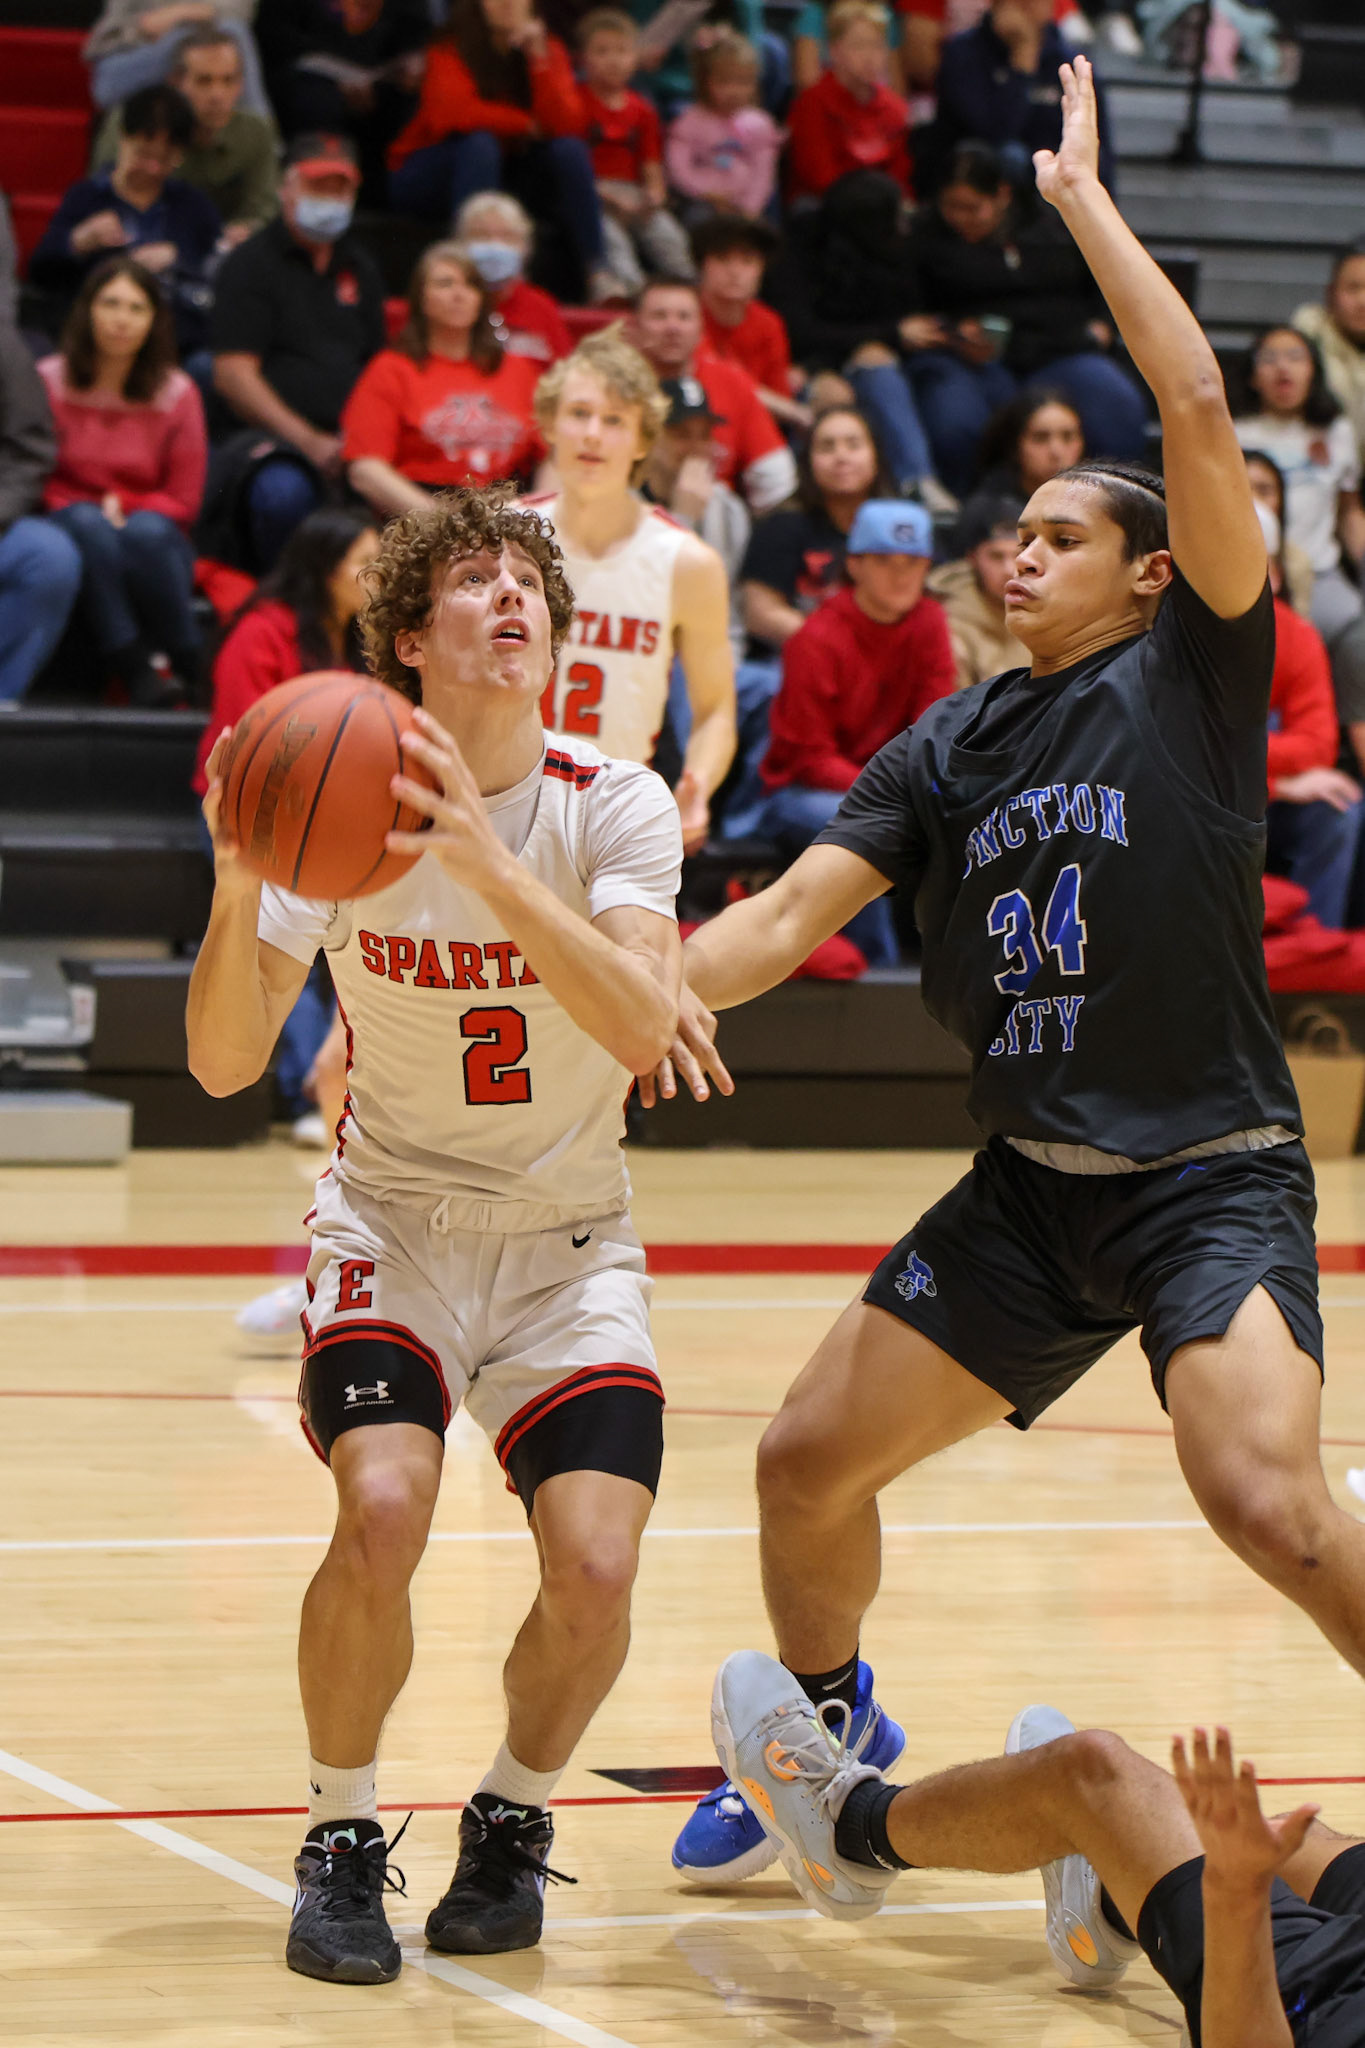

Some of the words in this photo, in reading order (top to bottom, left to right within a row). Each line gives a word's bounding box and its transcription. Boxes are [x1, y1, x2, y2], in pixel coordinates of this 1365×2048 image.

[572, 609, 661, 655] TANS
[986, 863, 1088, 996] 34
[459, 1005, 532, 1106] 2
[334, 1259, 375, 1313] E
